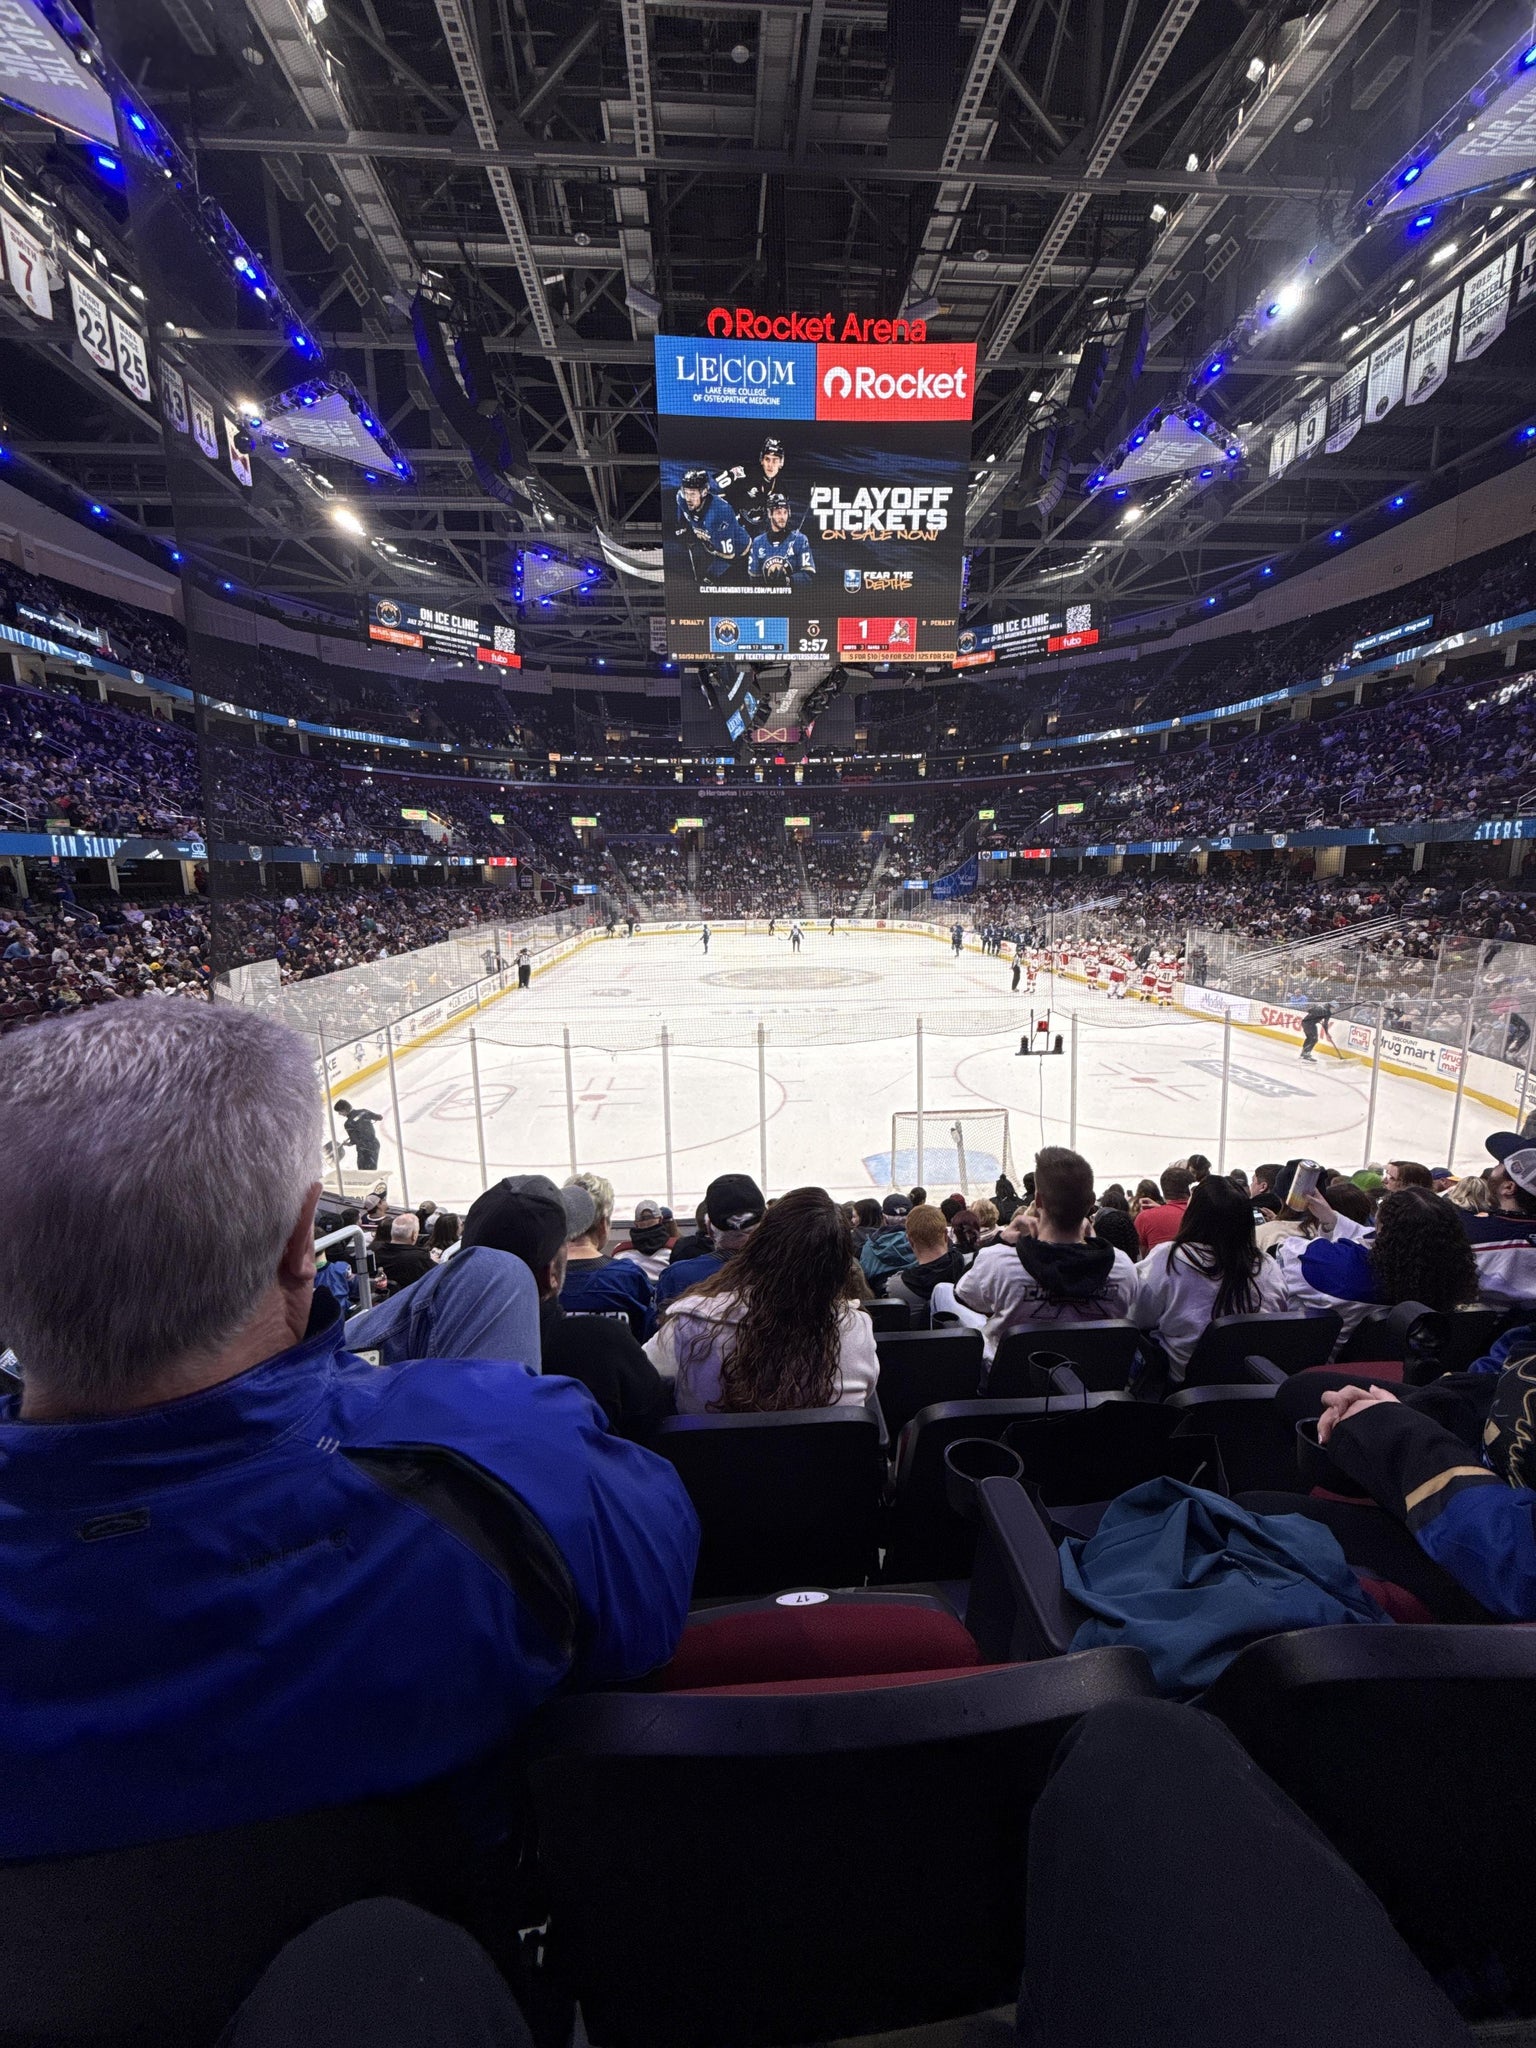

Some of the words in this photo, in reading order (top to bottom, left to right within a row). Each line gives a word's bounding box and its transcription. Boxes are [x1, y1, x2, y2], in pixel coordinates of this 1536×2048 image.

[18, 250, 33, 292] 7
[79, 306, 111, 360] 22
[735, 307, 836, 342] Rocket
[840, 313, 927, 342] Arena
[120, 343, 147, 390] 25
[705, 386, 721, 395] LAKE
[723, 387, 736, 396] ERIE
[738, 388, 767, 396] COLLEGE
[857, 365, 968, 400] Rocket
[693, 394, 702, 402] OF
[703, 395, 748, 404] OSTEOPATHIC
[749, 396, 781, 405] MEDICINE
[1306, 417, 1316, 445] 9
[810, 486, 953, 509] PLAYOFF
[813, 508, 948, 531] TICKETS
[821, 529, 846, 540] ON
[850, 528, 893, 542] SALE
[897, 529, 938, 542] NOW!
[720, 538, 733, 554] 16
[801, 552, 811, 566] 12
[863, 571, 890, 580] FEAR
[893, 571, 913, 579] THE
[865, 579, 912, 591] DEPTHS
[420, 607, 433, 622] ON
[435, 611, 450, 625] ICE
[451, 615, 480, 633] CLINIC
[754, 619, 765, 639] 1
[858, 619, 868, 639] 1
[992, 623, 1004, 635] ON
[1006, 618, 1019, 632] ICE
[1021, 612, 1050, 629] CLINIC
[798, 638, 829, 652] 3:57
[1062, 636, 1082, 647] fubo
[52, 835, 77, 857] FAN
[1351, 1027, 1368, 1041] drug
[1351, 1037, 1370, 1047] mart
[1392, 1035, 1418, 1046] DISCOUNT
[1373, 1037, 1401, 1056] drug
[1403, 1044, 1436, 1063] mart
[1441, 1051, 1462, 1065] drug
